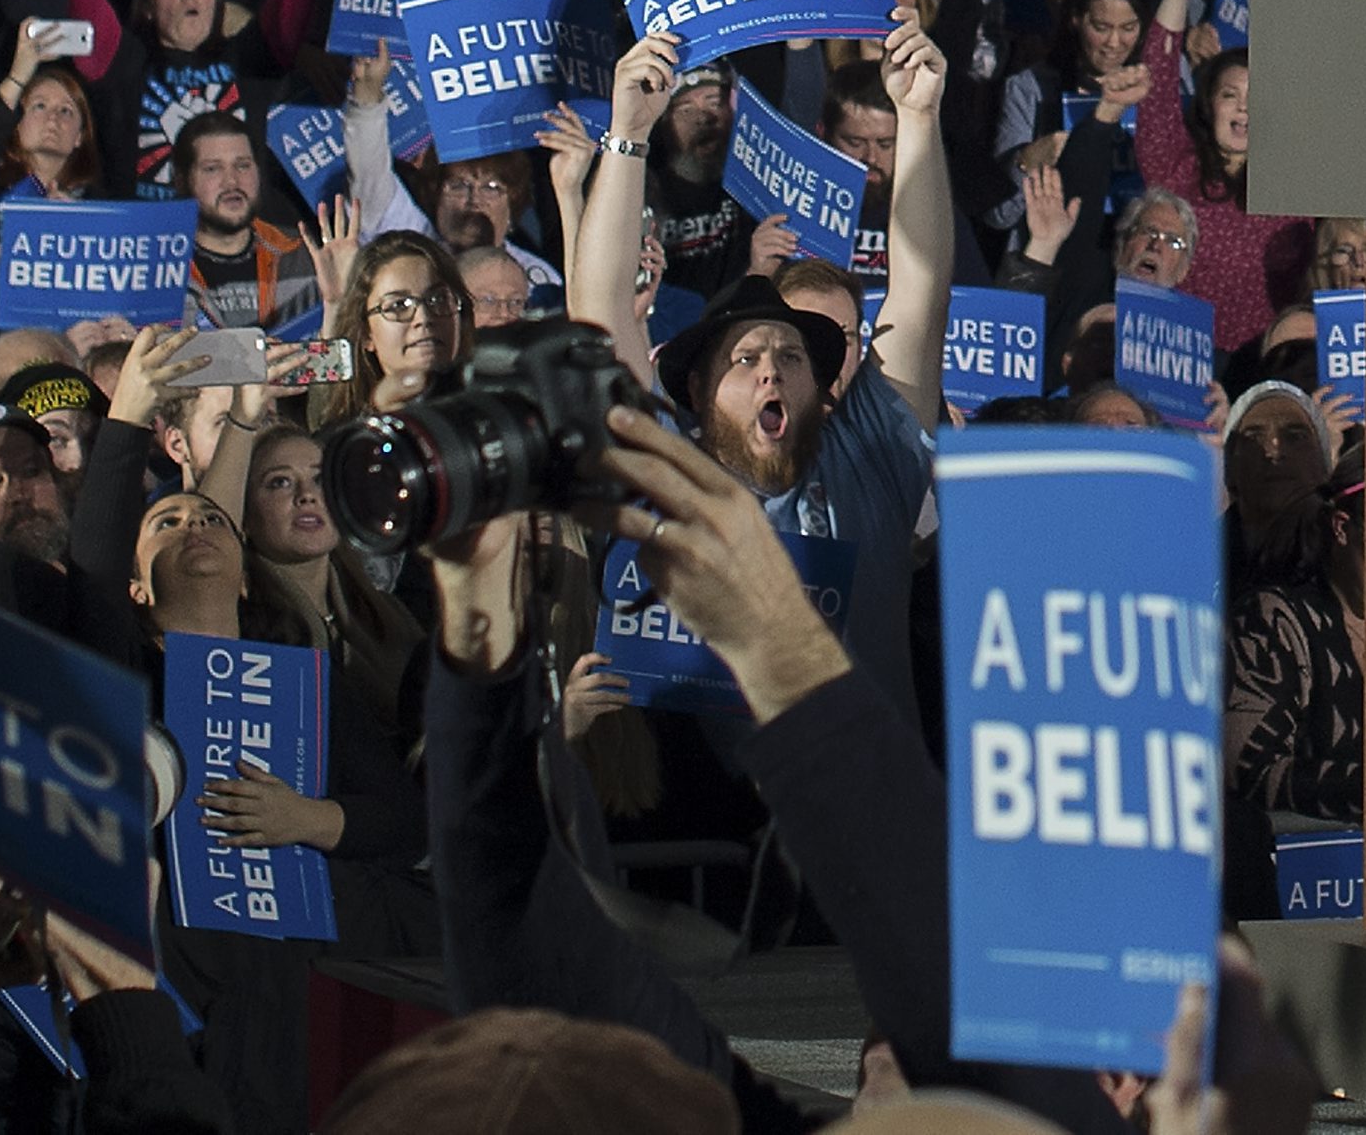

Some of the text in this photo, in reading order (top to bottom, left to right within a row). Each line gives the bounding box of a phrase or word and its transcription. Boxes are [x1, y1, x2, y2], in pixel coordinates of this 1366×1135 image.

[427, 32, 452, 62] A
[733, 133, 851, 239] BELIEVE IN
[749, 120, 854, 211] FUTURE TO
[12, 233, 189, 260] A FUTURE TO
[8, 262, 185, 291] BELIEVE IN
[1137, 313, 1212, 356] FUTURE TO
[1003, 351, 1036, 380] IN
[1122, 342, 1213, 387] BELIEVE IN
[971, 588, 1027, 691] A
[241, 652, 272, 705] IN
[207, 648, 241, 917] A TO
[0, 758, 126, 865] IN
